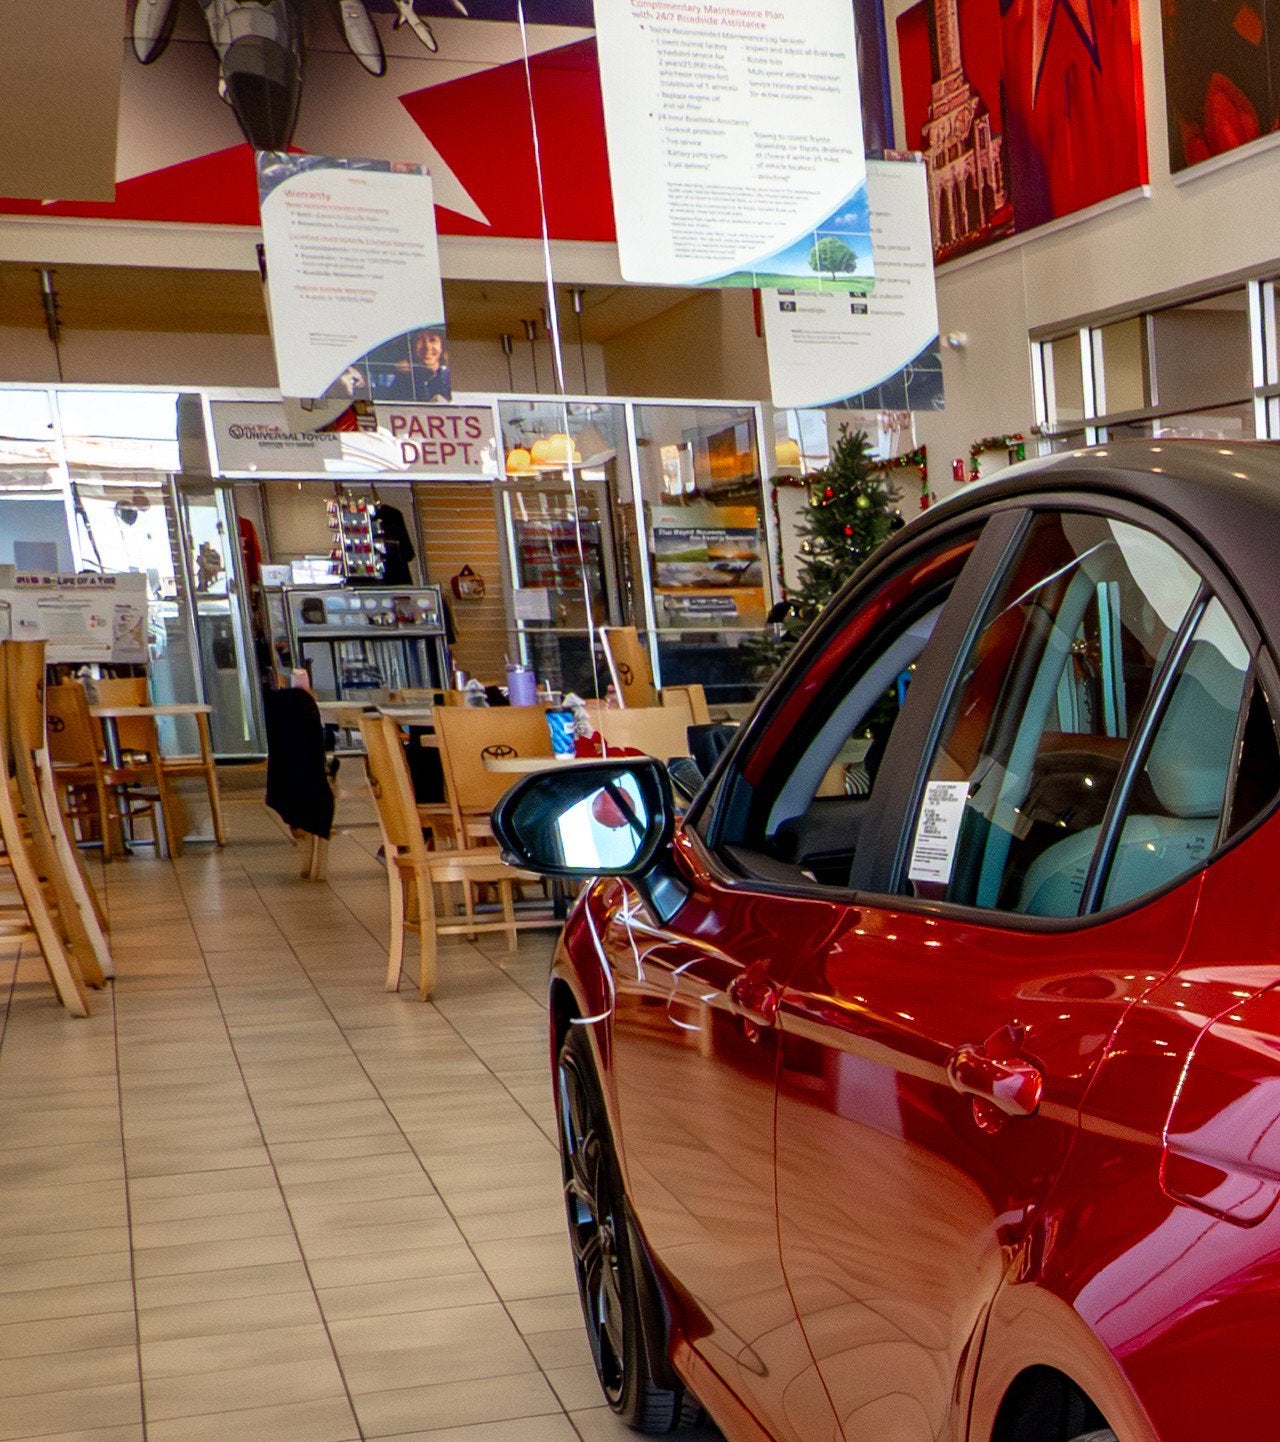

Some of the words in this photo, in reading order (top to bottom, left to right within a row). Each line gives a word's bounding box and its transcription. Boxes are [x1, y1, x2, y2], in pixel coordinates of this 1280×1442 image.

[656, 12, 674, 21] 24/7
[677, 14, 718, 25] Roadside
[721, 18, 767, 30] Assistance
[703, 5, 763, 18] Maintenance
[764, 10, 785, 20] Plan
[245, 431, 299, 441] UNIVERSAL
[390, 415, 482, 440] PARTS
[401, 443, 479, 465] DEPT.
